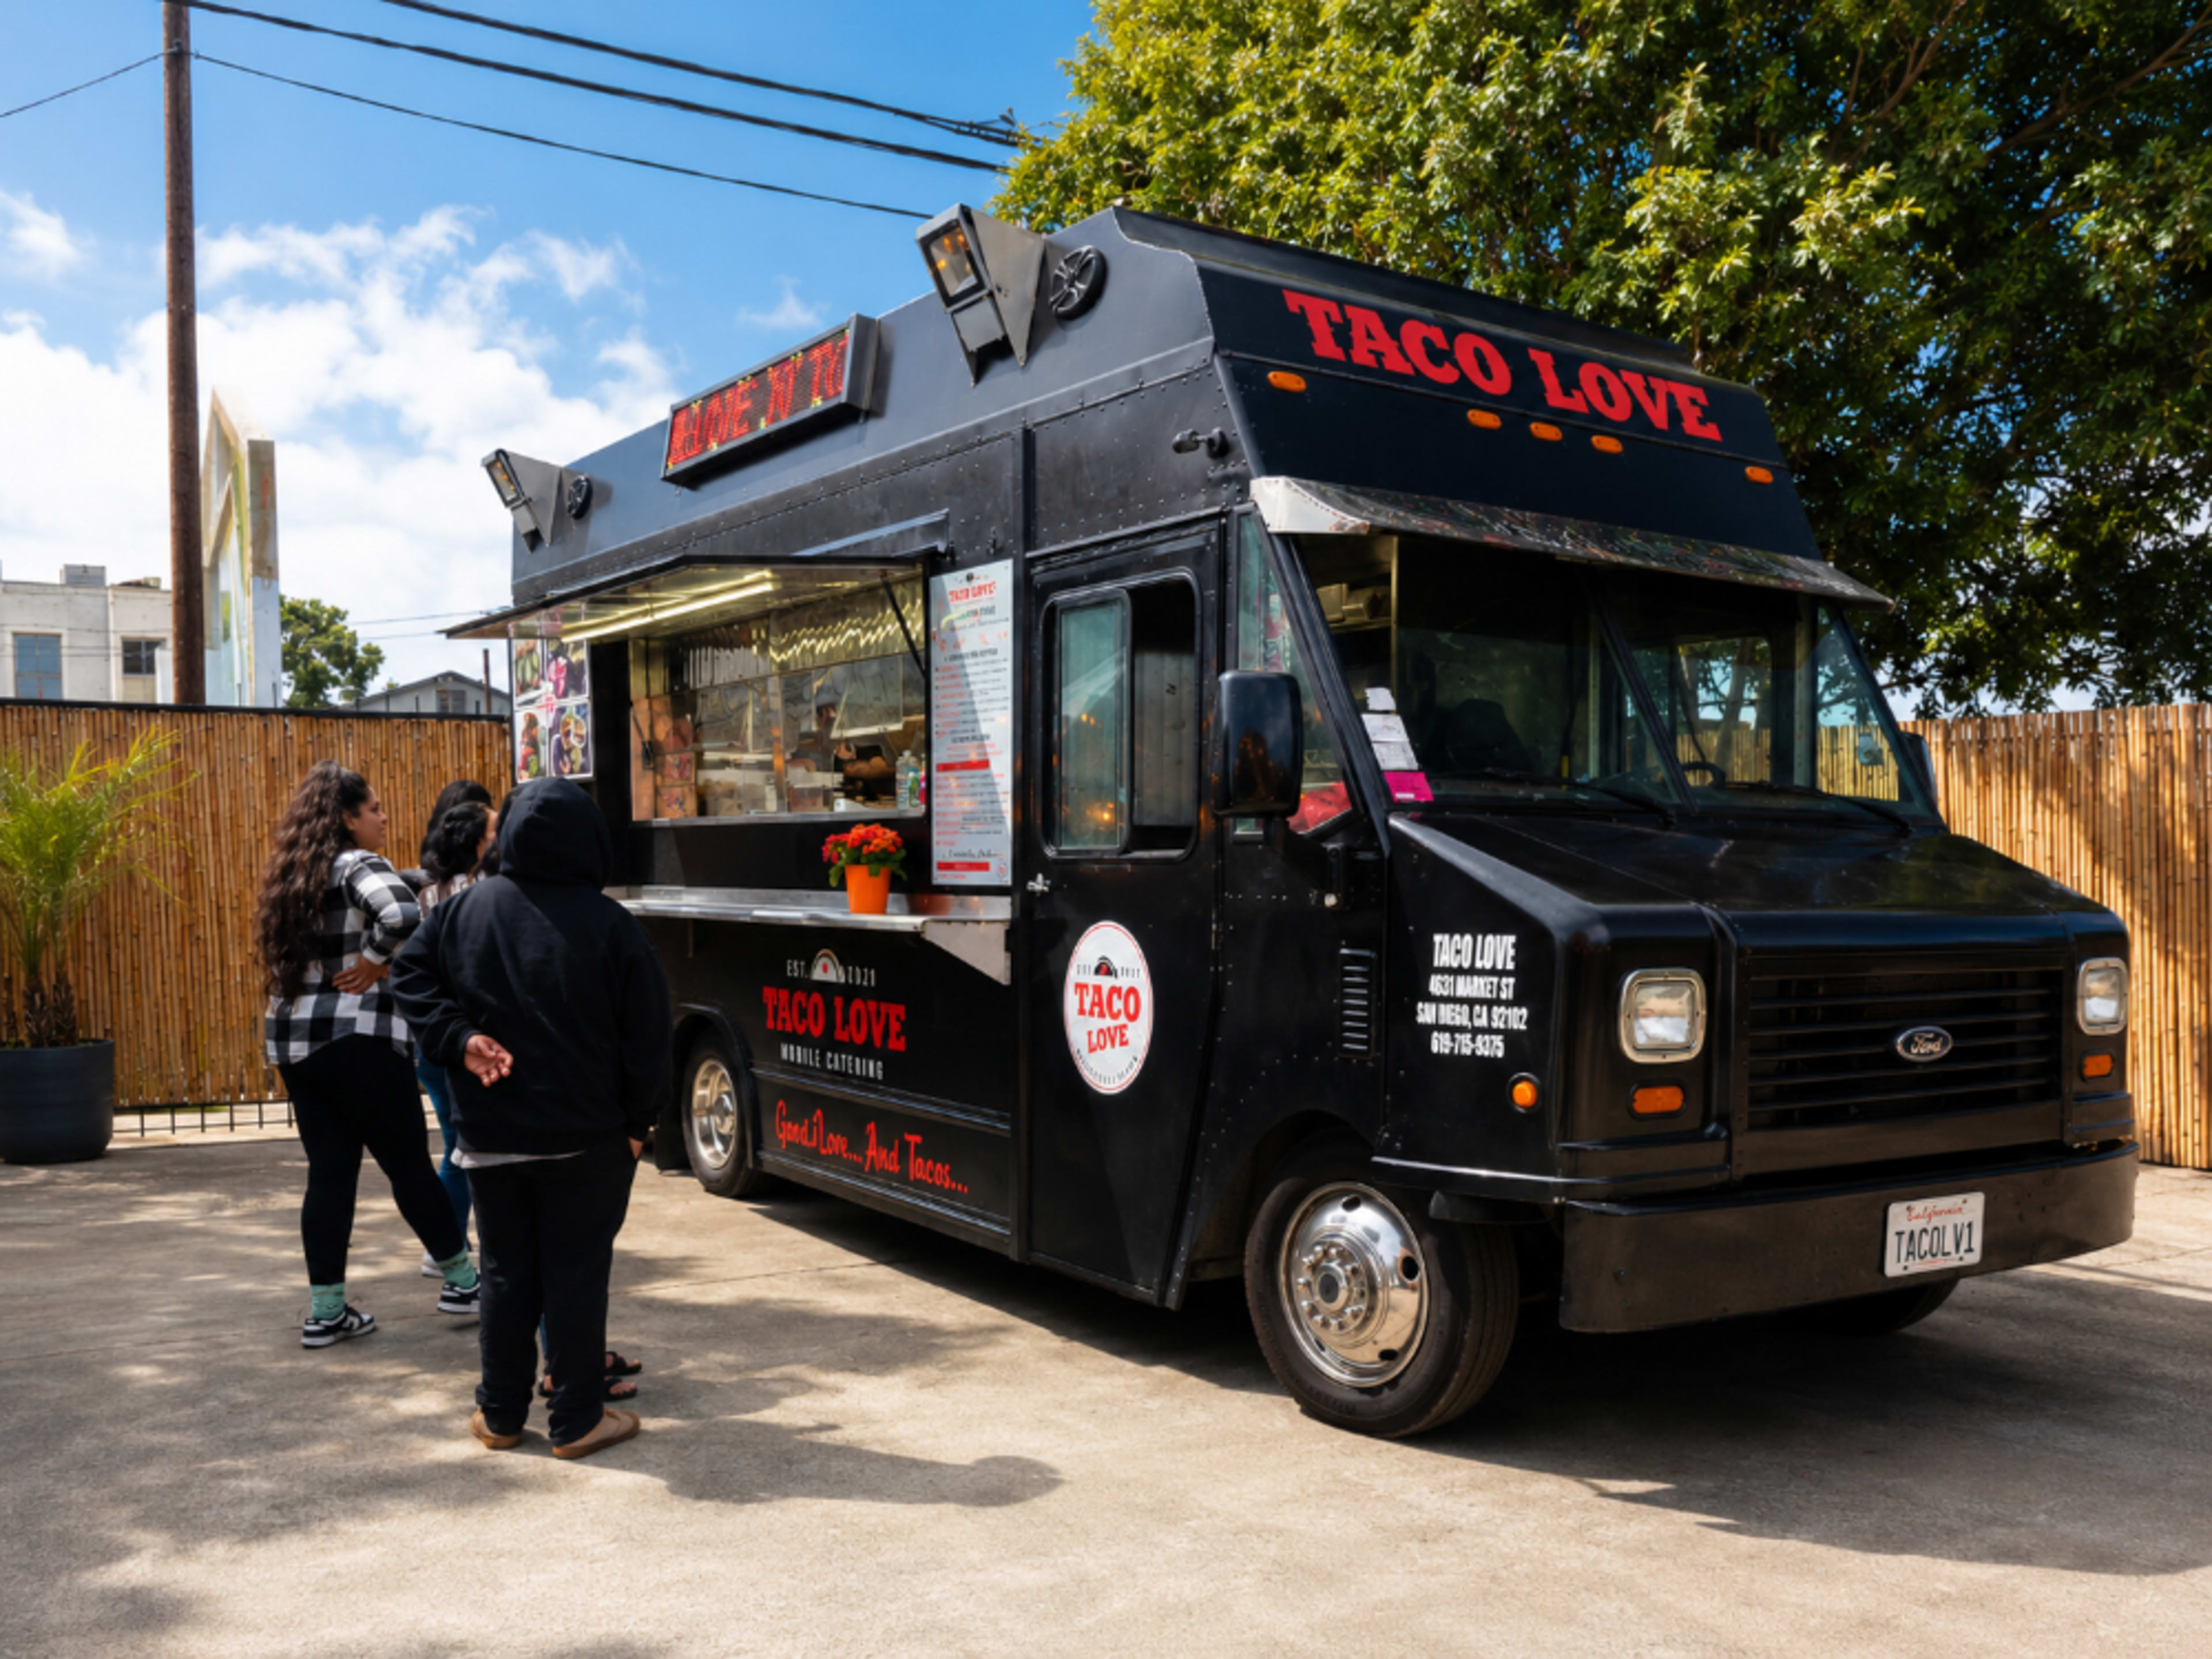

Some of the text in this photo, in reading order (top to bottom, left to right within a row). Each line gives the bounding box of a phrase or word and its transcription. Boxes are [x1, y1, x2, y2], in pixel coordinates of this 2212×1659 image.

[1282, 289, 1722, 442] TACO LOVE
[1433, 933, 1516, 970] TACO LOVE
[1074, 982, 1141, 1022] TACO
[1456, 975, 1499, 998] MARKET
[1499, 977, 1516, 1000] ST
[762, 986, 906, 1052] TACO LOVE
[1416, 1002, 1436, 1024] SAN
[1473, 1005, 1488, 1028] CA
[1491, 1006, 1528, 1029] 92102
[1087, 1024, 1129, 1054] LOVE
[1911, 1032, 1943, 1054] Ford
[781, 1043, 884, 1080] MOBILE CATERING
[776, 1099, 810, 1150] Good
[865, 1121, 900, 1173] And
[904, 1132, 969, 1194] Tacos...
[1906, 1203, 1964, 1225] California
[1895, 1221, 1975, 1264] TACOLV1
